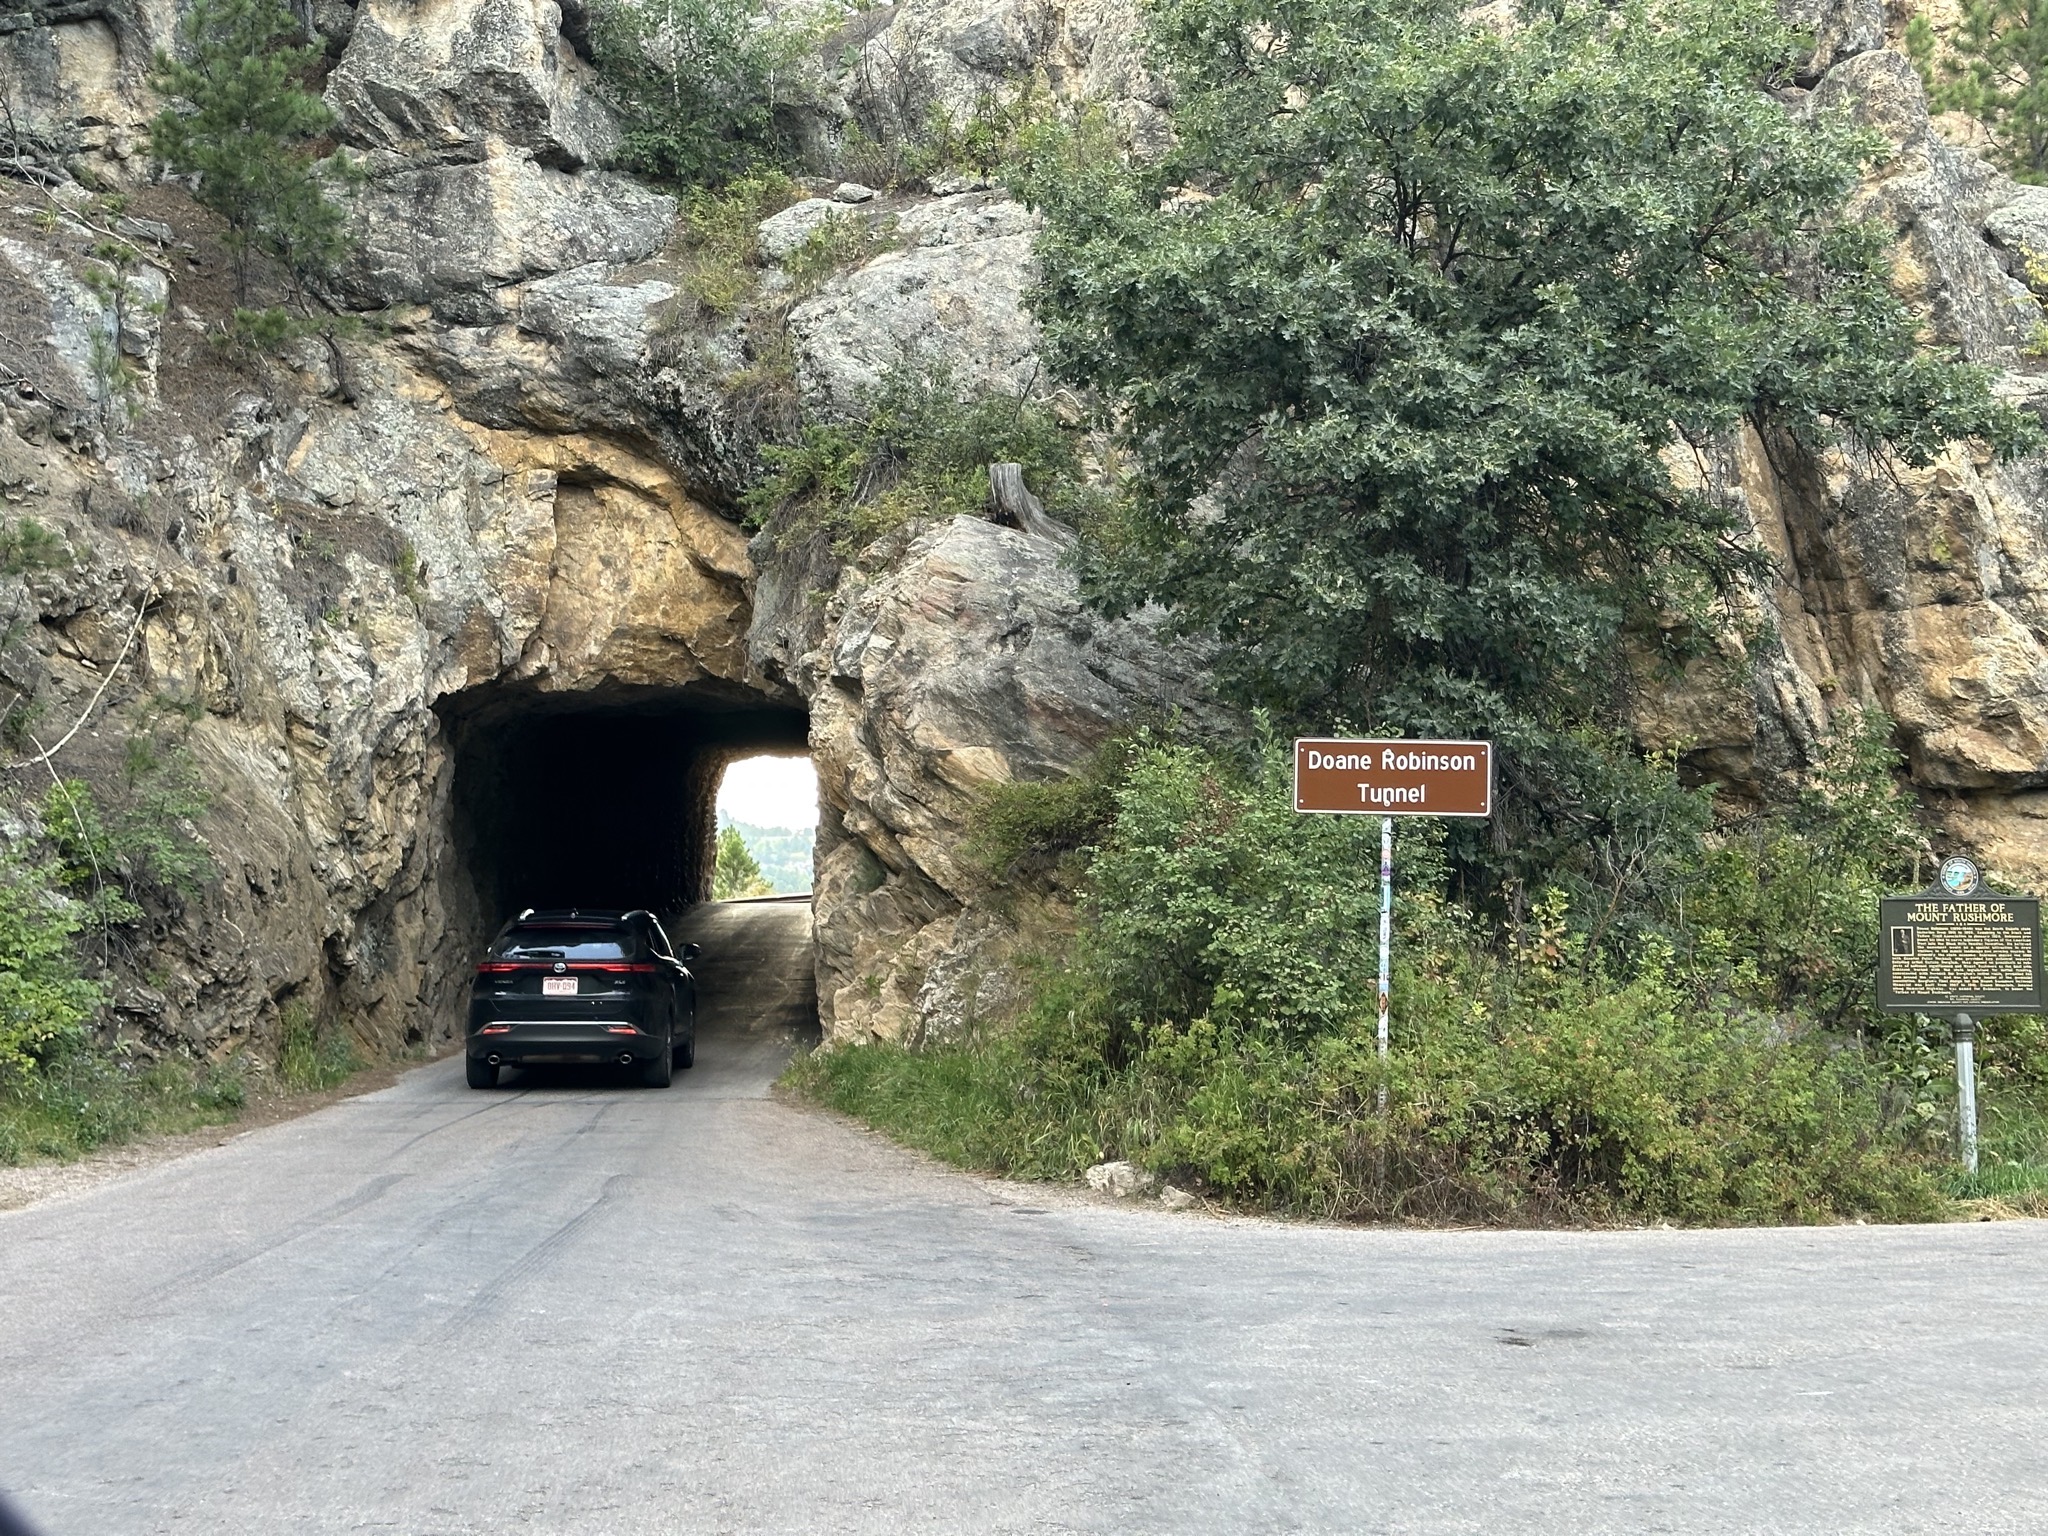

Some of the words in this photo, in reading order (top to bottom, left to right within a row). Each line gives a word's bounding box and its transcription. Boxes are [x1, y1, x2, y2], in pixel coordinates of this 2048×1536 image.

[1308, 750, 1372, 770] Doane
[1381, 750, 1476, 771] Robinson
[1357, 783, 1425, 803] Tunnel
[1915, 903, 1939, 912] THE
[1942, 903, 1986, 913] FATHER
[1990, 903, 2005, 913] OF
[1907, 912, 1948, 922] MOUNT
[1953, 913, 2014, 923] RUSHMORE
